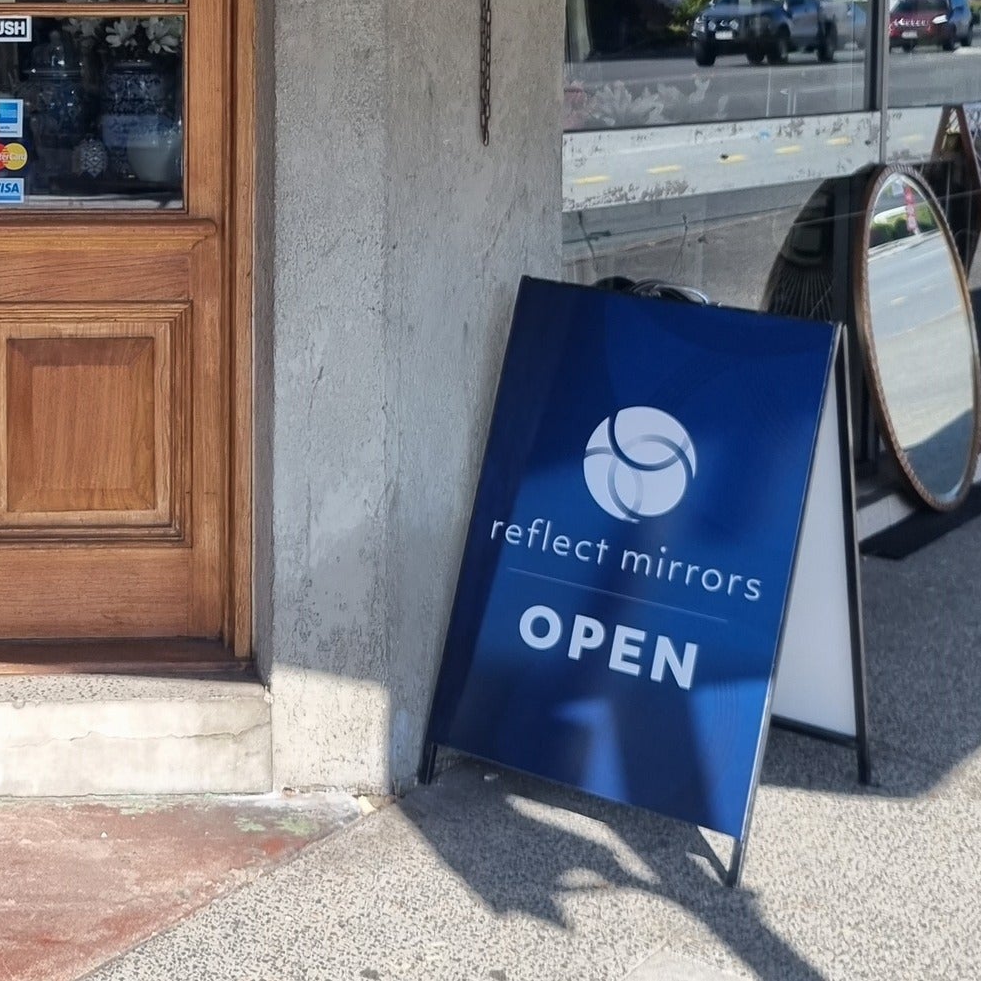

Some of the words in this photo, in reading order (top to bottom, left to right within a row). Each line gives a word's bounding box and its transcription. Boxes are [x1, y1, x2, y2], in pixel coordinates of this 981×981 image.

[490, 518, 609, 565] reflect
[620, 545, 763, 602] mirrors
[519, 604, 700, 691] OPEN
